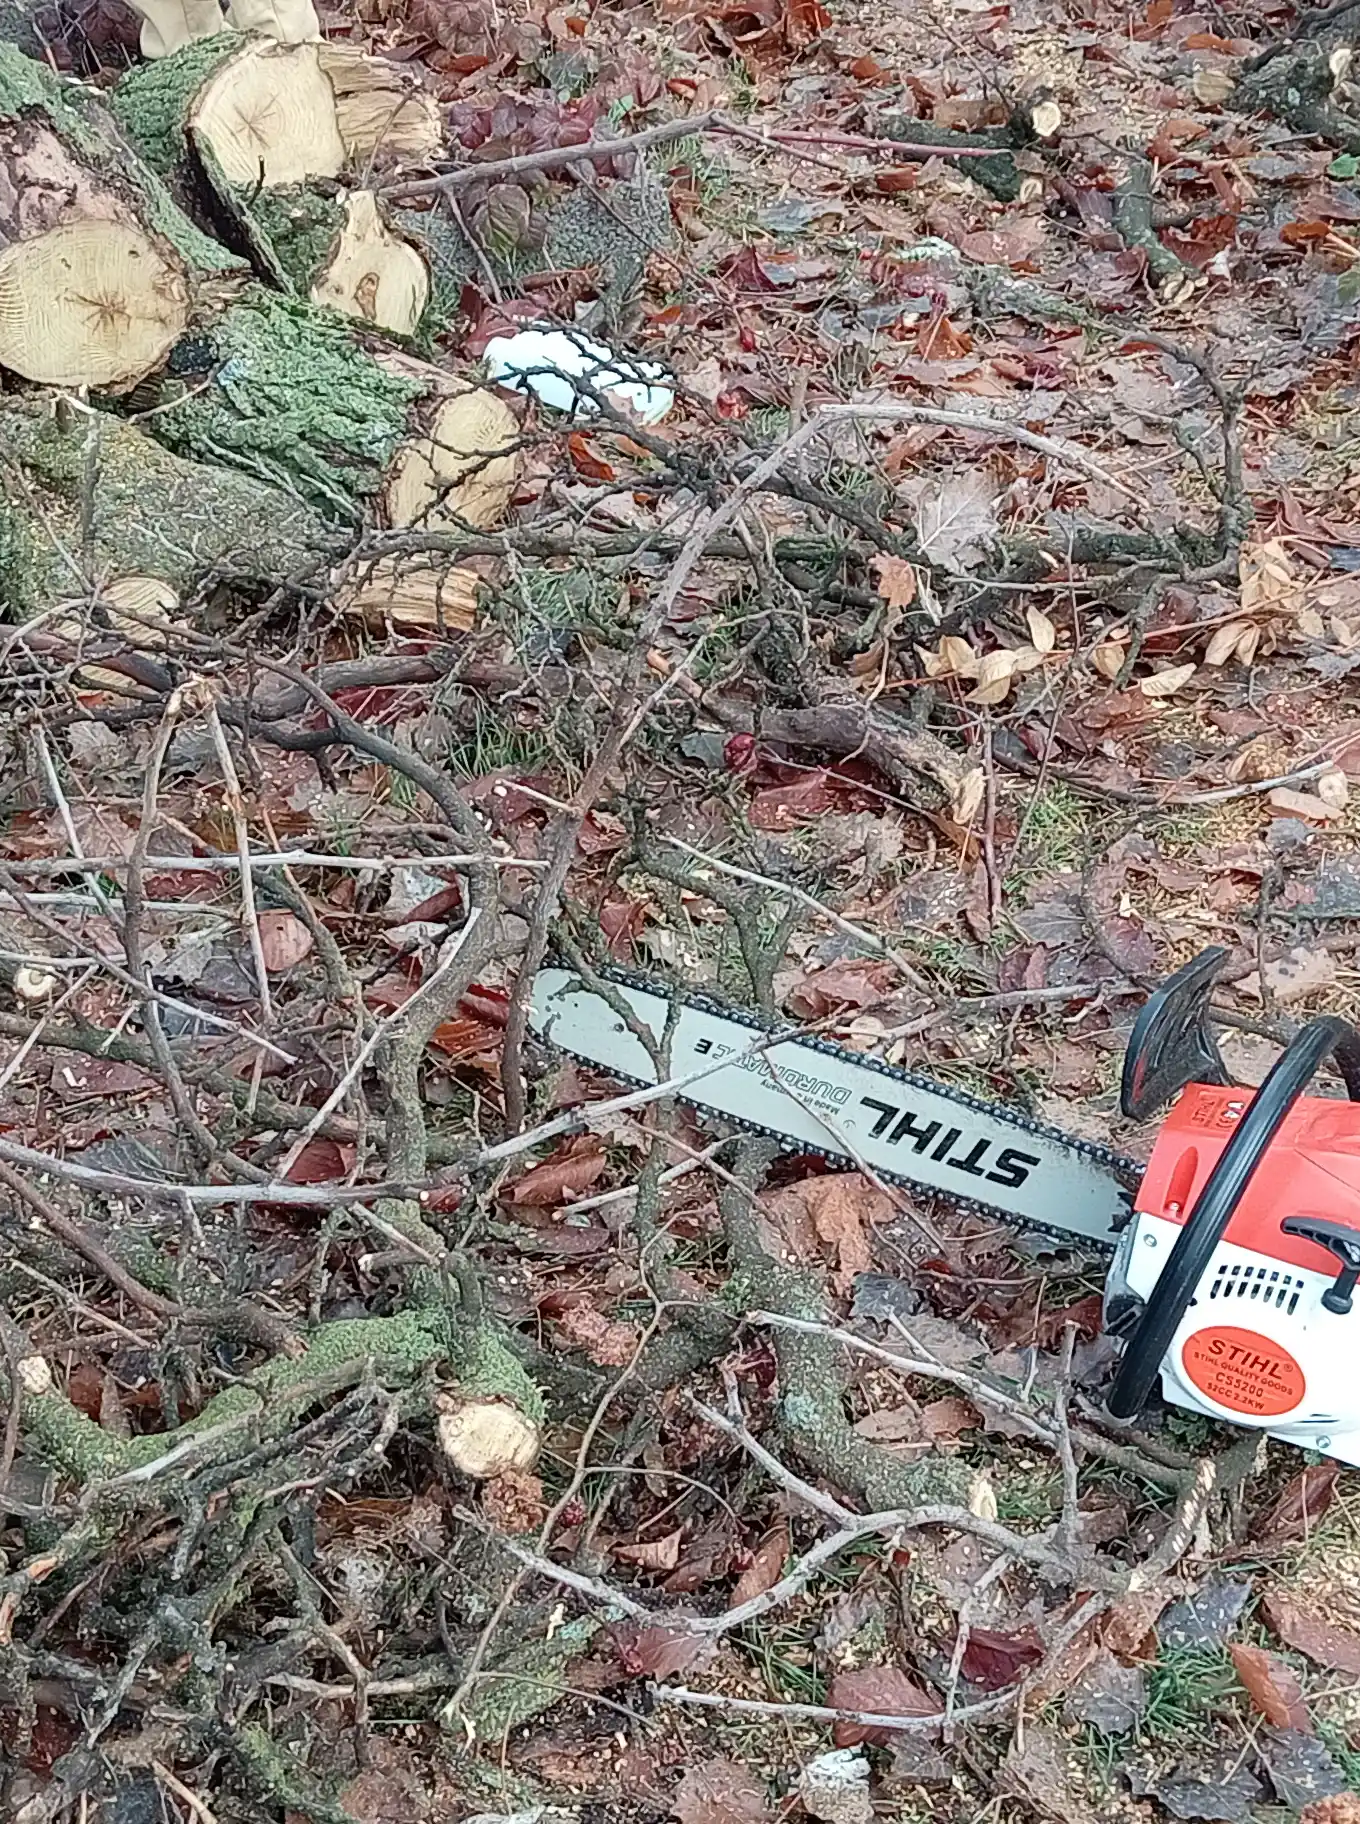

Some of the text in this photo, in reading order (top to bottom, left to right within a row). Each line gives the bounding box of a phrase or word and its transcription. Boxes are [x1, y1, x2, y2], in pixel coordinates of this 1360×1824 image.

[694, 1038, 852, 1105] DUROMATC E
[814, 1099, 840, 1115] Made
[860, 1096, 1041, 1188] STIHL
[1194, 1352, 1293, 1395] STIHL QUALITY GOODS
[1208, 1339, 1282, 1380] STIHL
[1207, 1381, 1264, 1410] 52CC 2.2KW
[1215, 1371, 1264, 1398] CS5200
